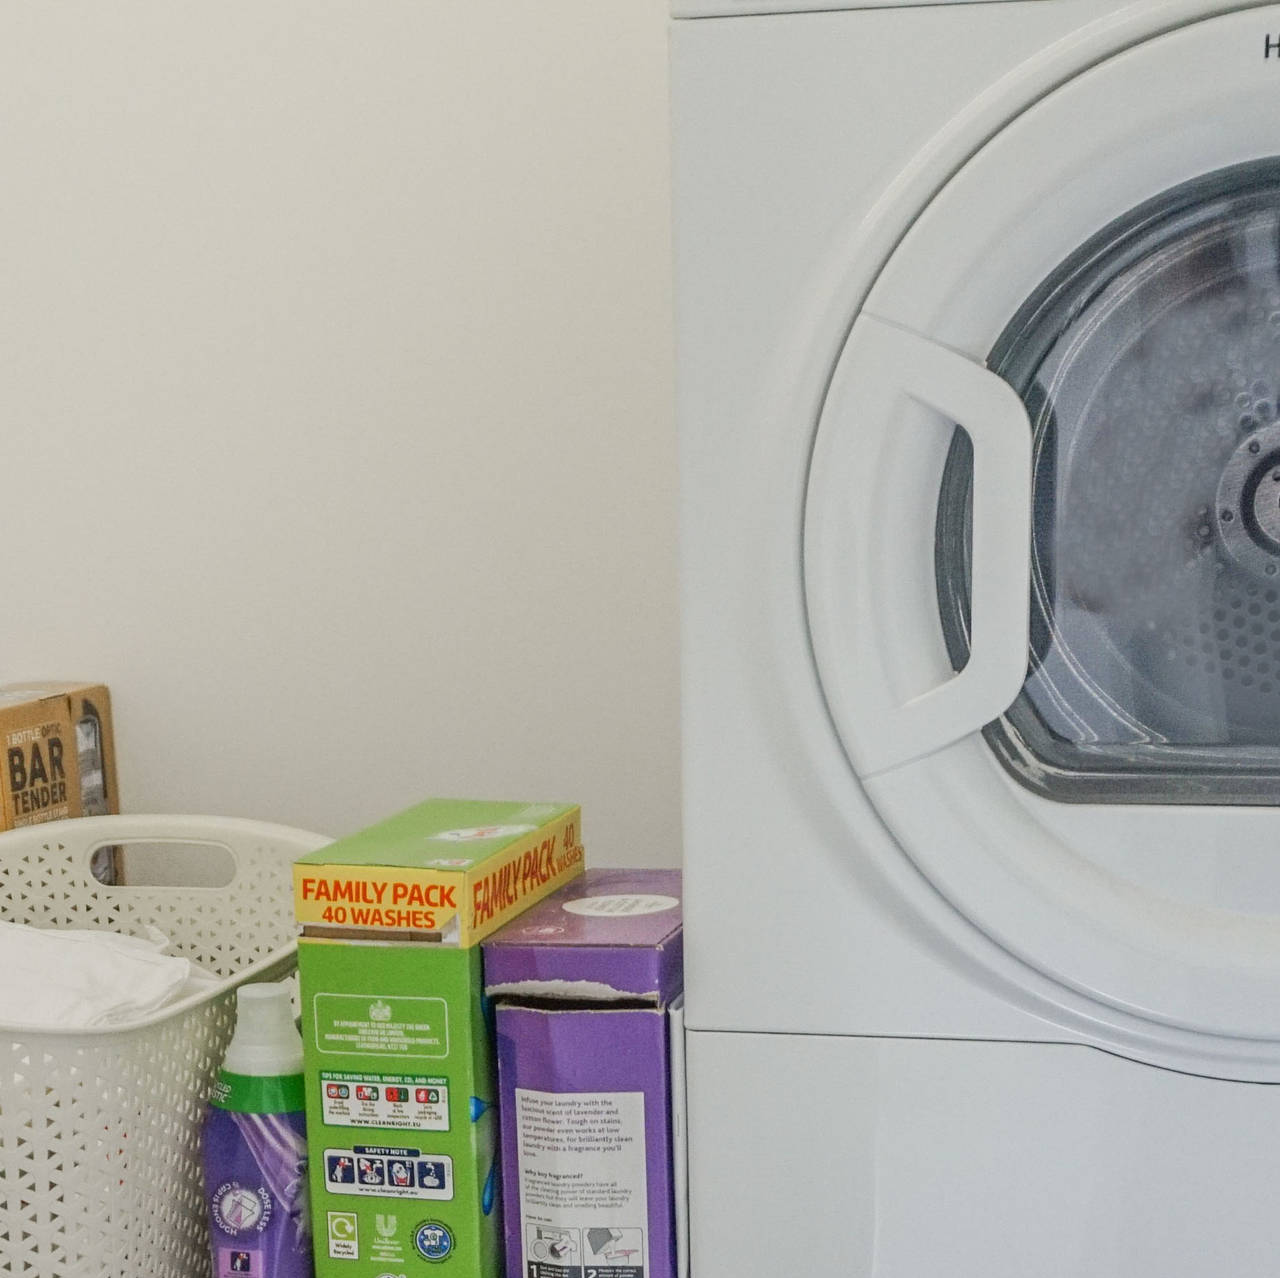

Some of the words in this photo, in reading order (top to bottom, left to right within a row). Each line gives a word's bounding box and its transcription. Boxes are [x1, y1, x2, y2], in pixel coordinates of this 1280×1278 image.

[12, 728, 41, 745] BOTTLE
[7, 737, 65, 792] BAR
[13, 781, 67, 815] TENDER
[563, 823, 574, 850] 40
[556, 845, 583, 873] WASHES
[302, 878, 388, 904] FAMILY
[392, 882, 457, 908] PACK
[473, 856, 522, 929] FAMILY
[522, 835, 557, 896] PACK
[322, 906, 347, 923] 40
[350, 908, 436, 929] WASHES
[257, 1187, 272, 1210] DOSE
[256, 1210, 271, 1233] LESS
[530, 1264, 537, 1278] 1
